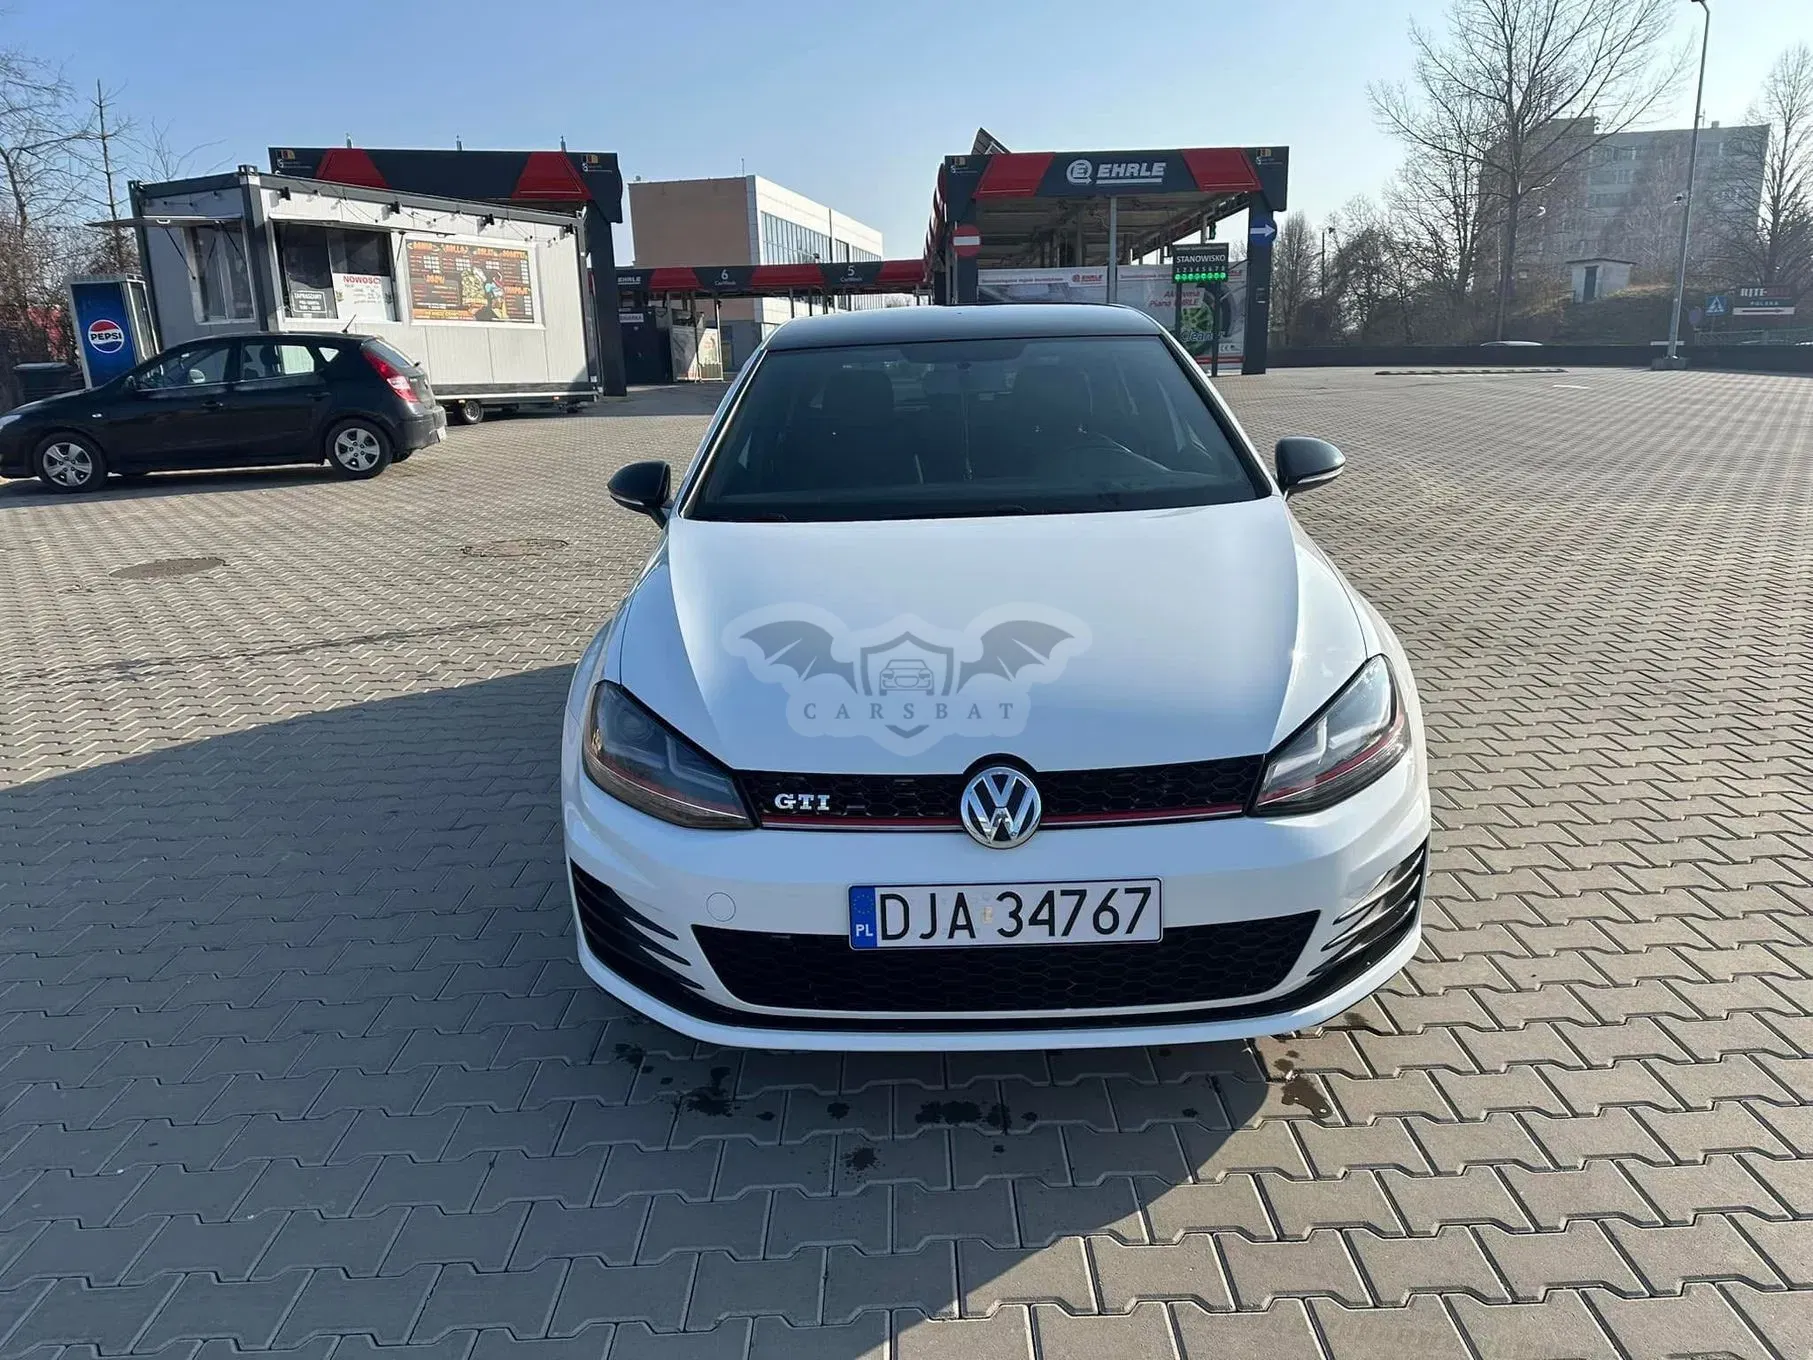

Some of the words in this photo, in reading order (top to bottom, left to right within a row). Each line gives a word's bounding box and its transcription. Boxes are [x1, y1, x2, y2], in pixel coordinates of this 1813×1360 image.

[1097, 162, 1167, 178] EHRLE
[1176, 254, 1226, 264] STANOWISKO
[721, 269, 729, 280] 6
[848, 265, 856, 276] 5
[91, 332, 122, 340] PEPSI
[774, 793, 831, 811] GTI
[856, 924, 873, 937] PL
[880, 892, 976, 941] DJA
[996, 886, 1152, 938] 34767
